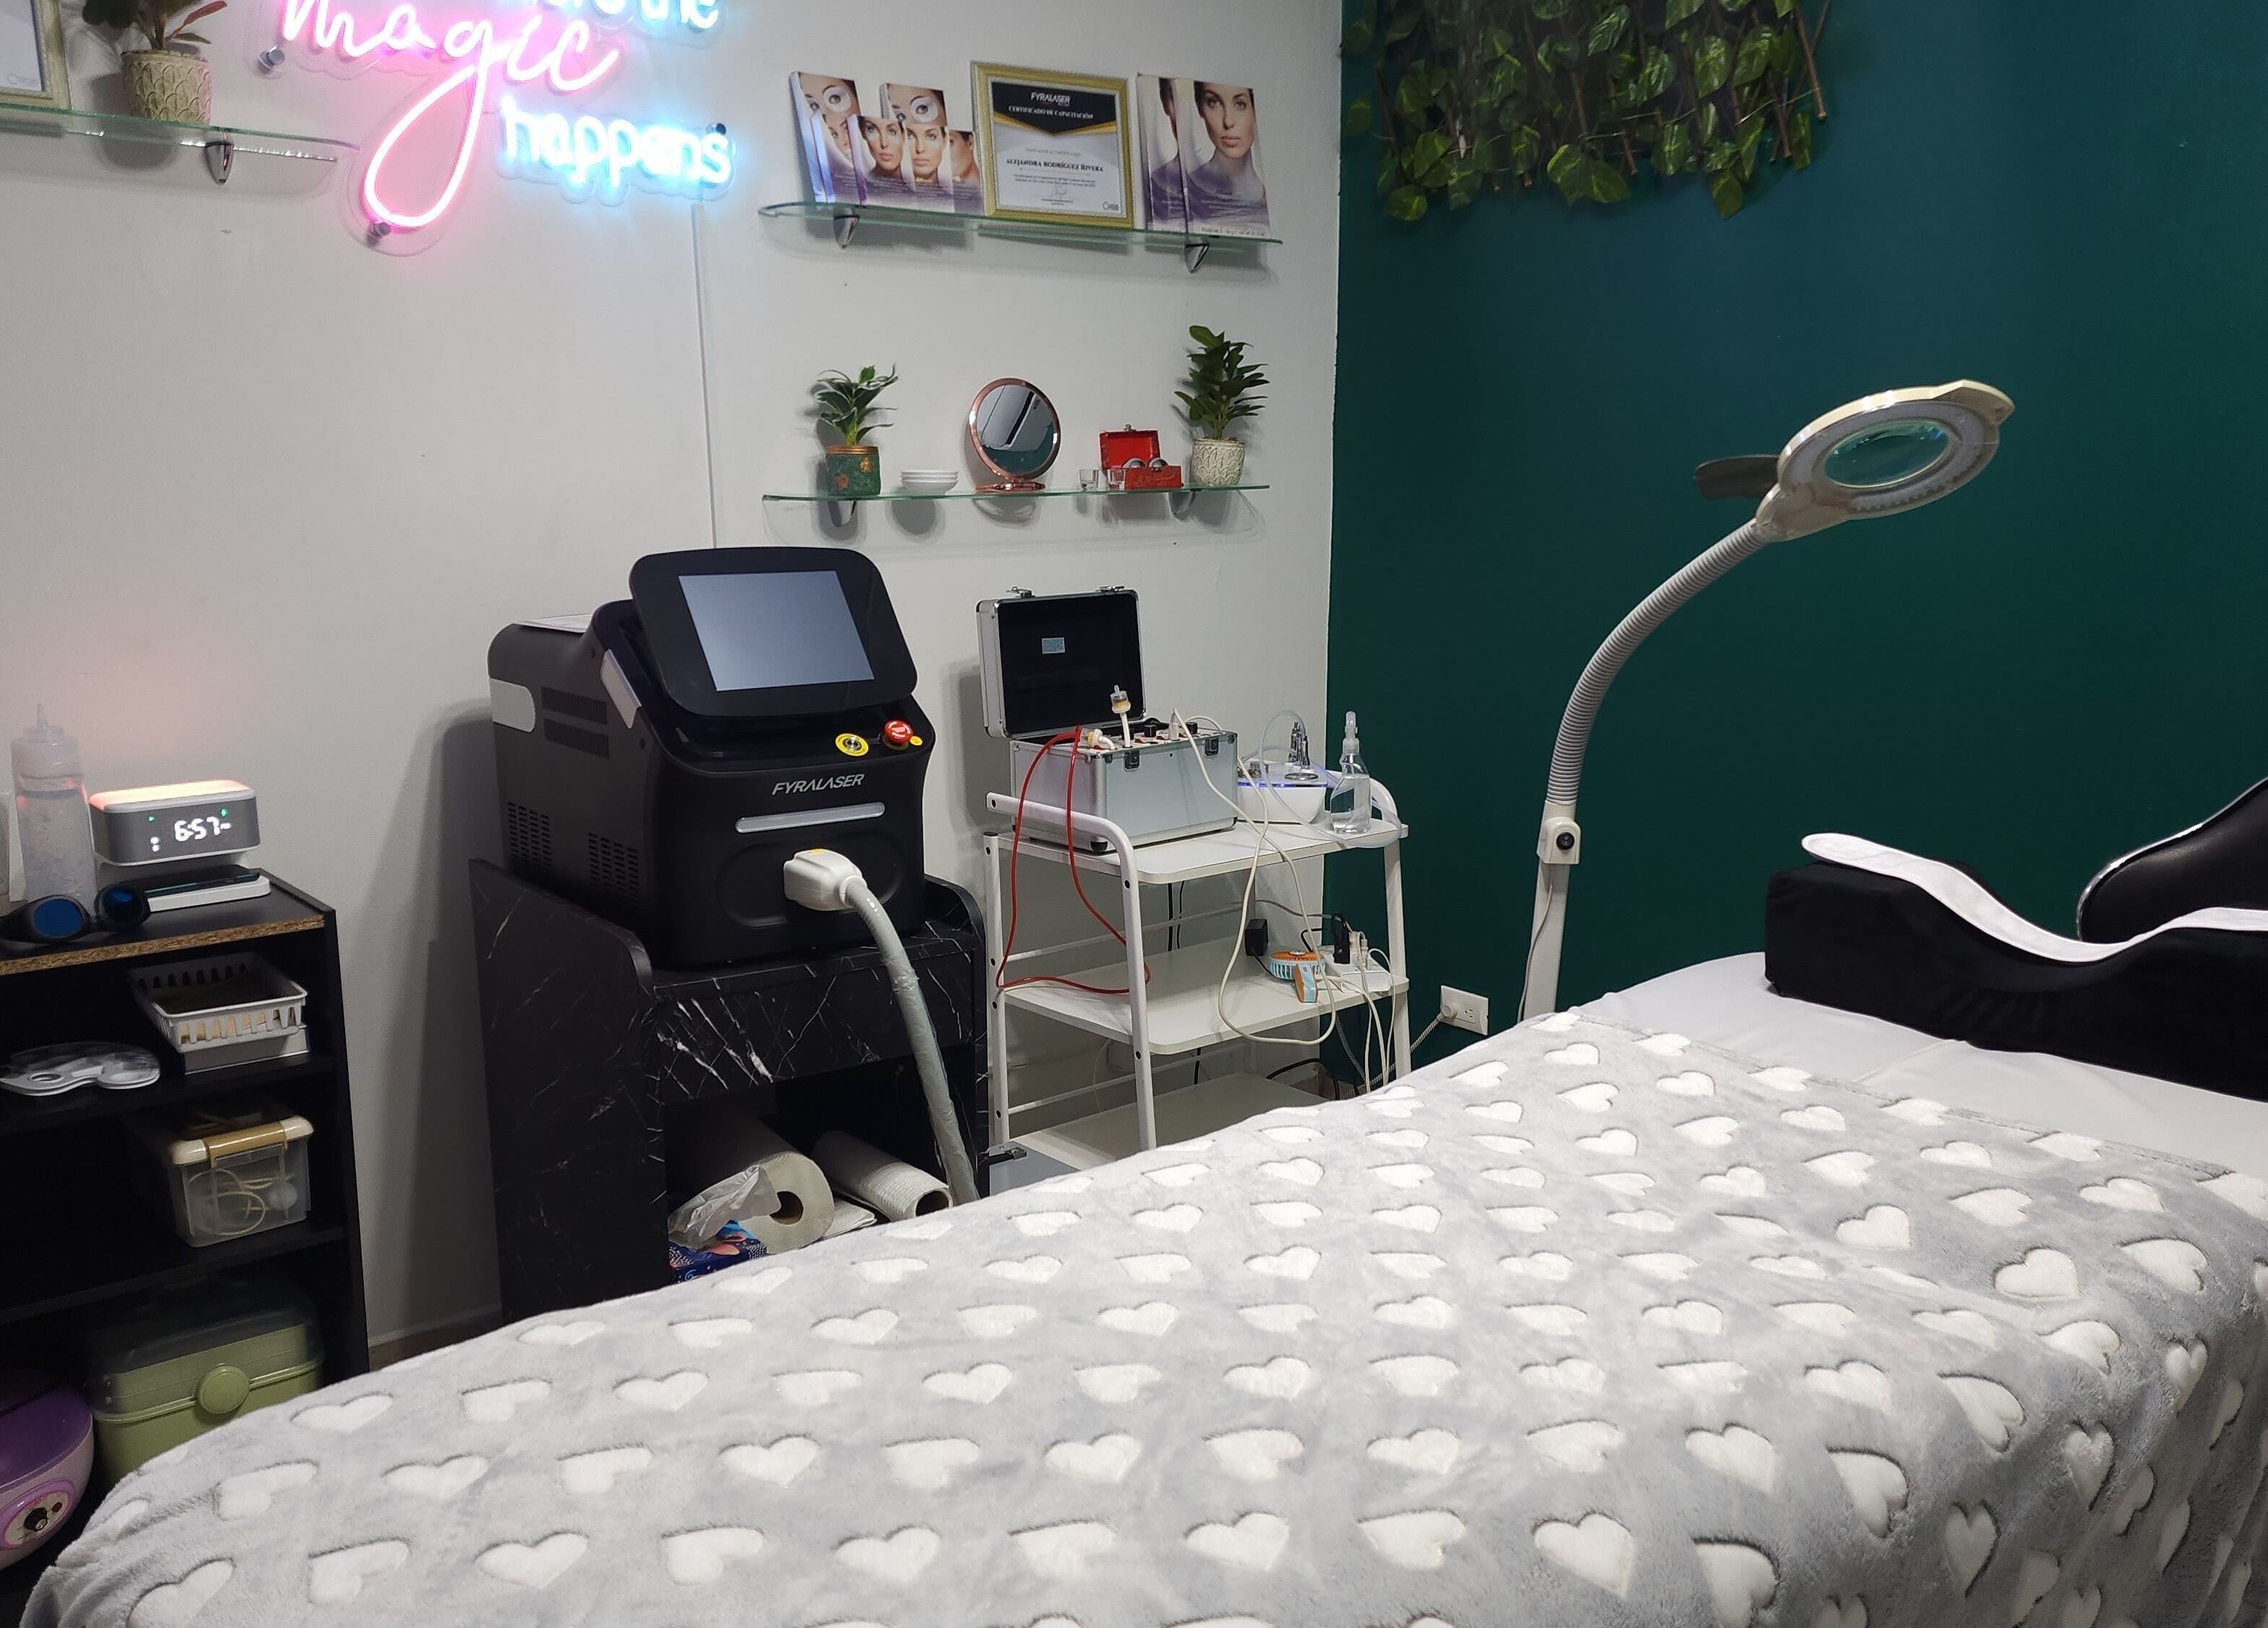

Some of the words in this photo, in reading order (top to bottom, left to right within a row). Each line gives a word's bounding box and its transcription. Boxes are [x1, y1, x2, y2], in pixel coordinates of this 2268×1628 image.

[1031, 92, 1071, 102] FYRALASER
[501, 93, 730, 187] happens
[1006, 158, 1042, 167] ALEJANDRA
[771, 773, 865, 796] FYRALASER
